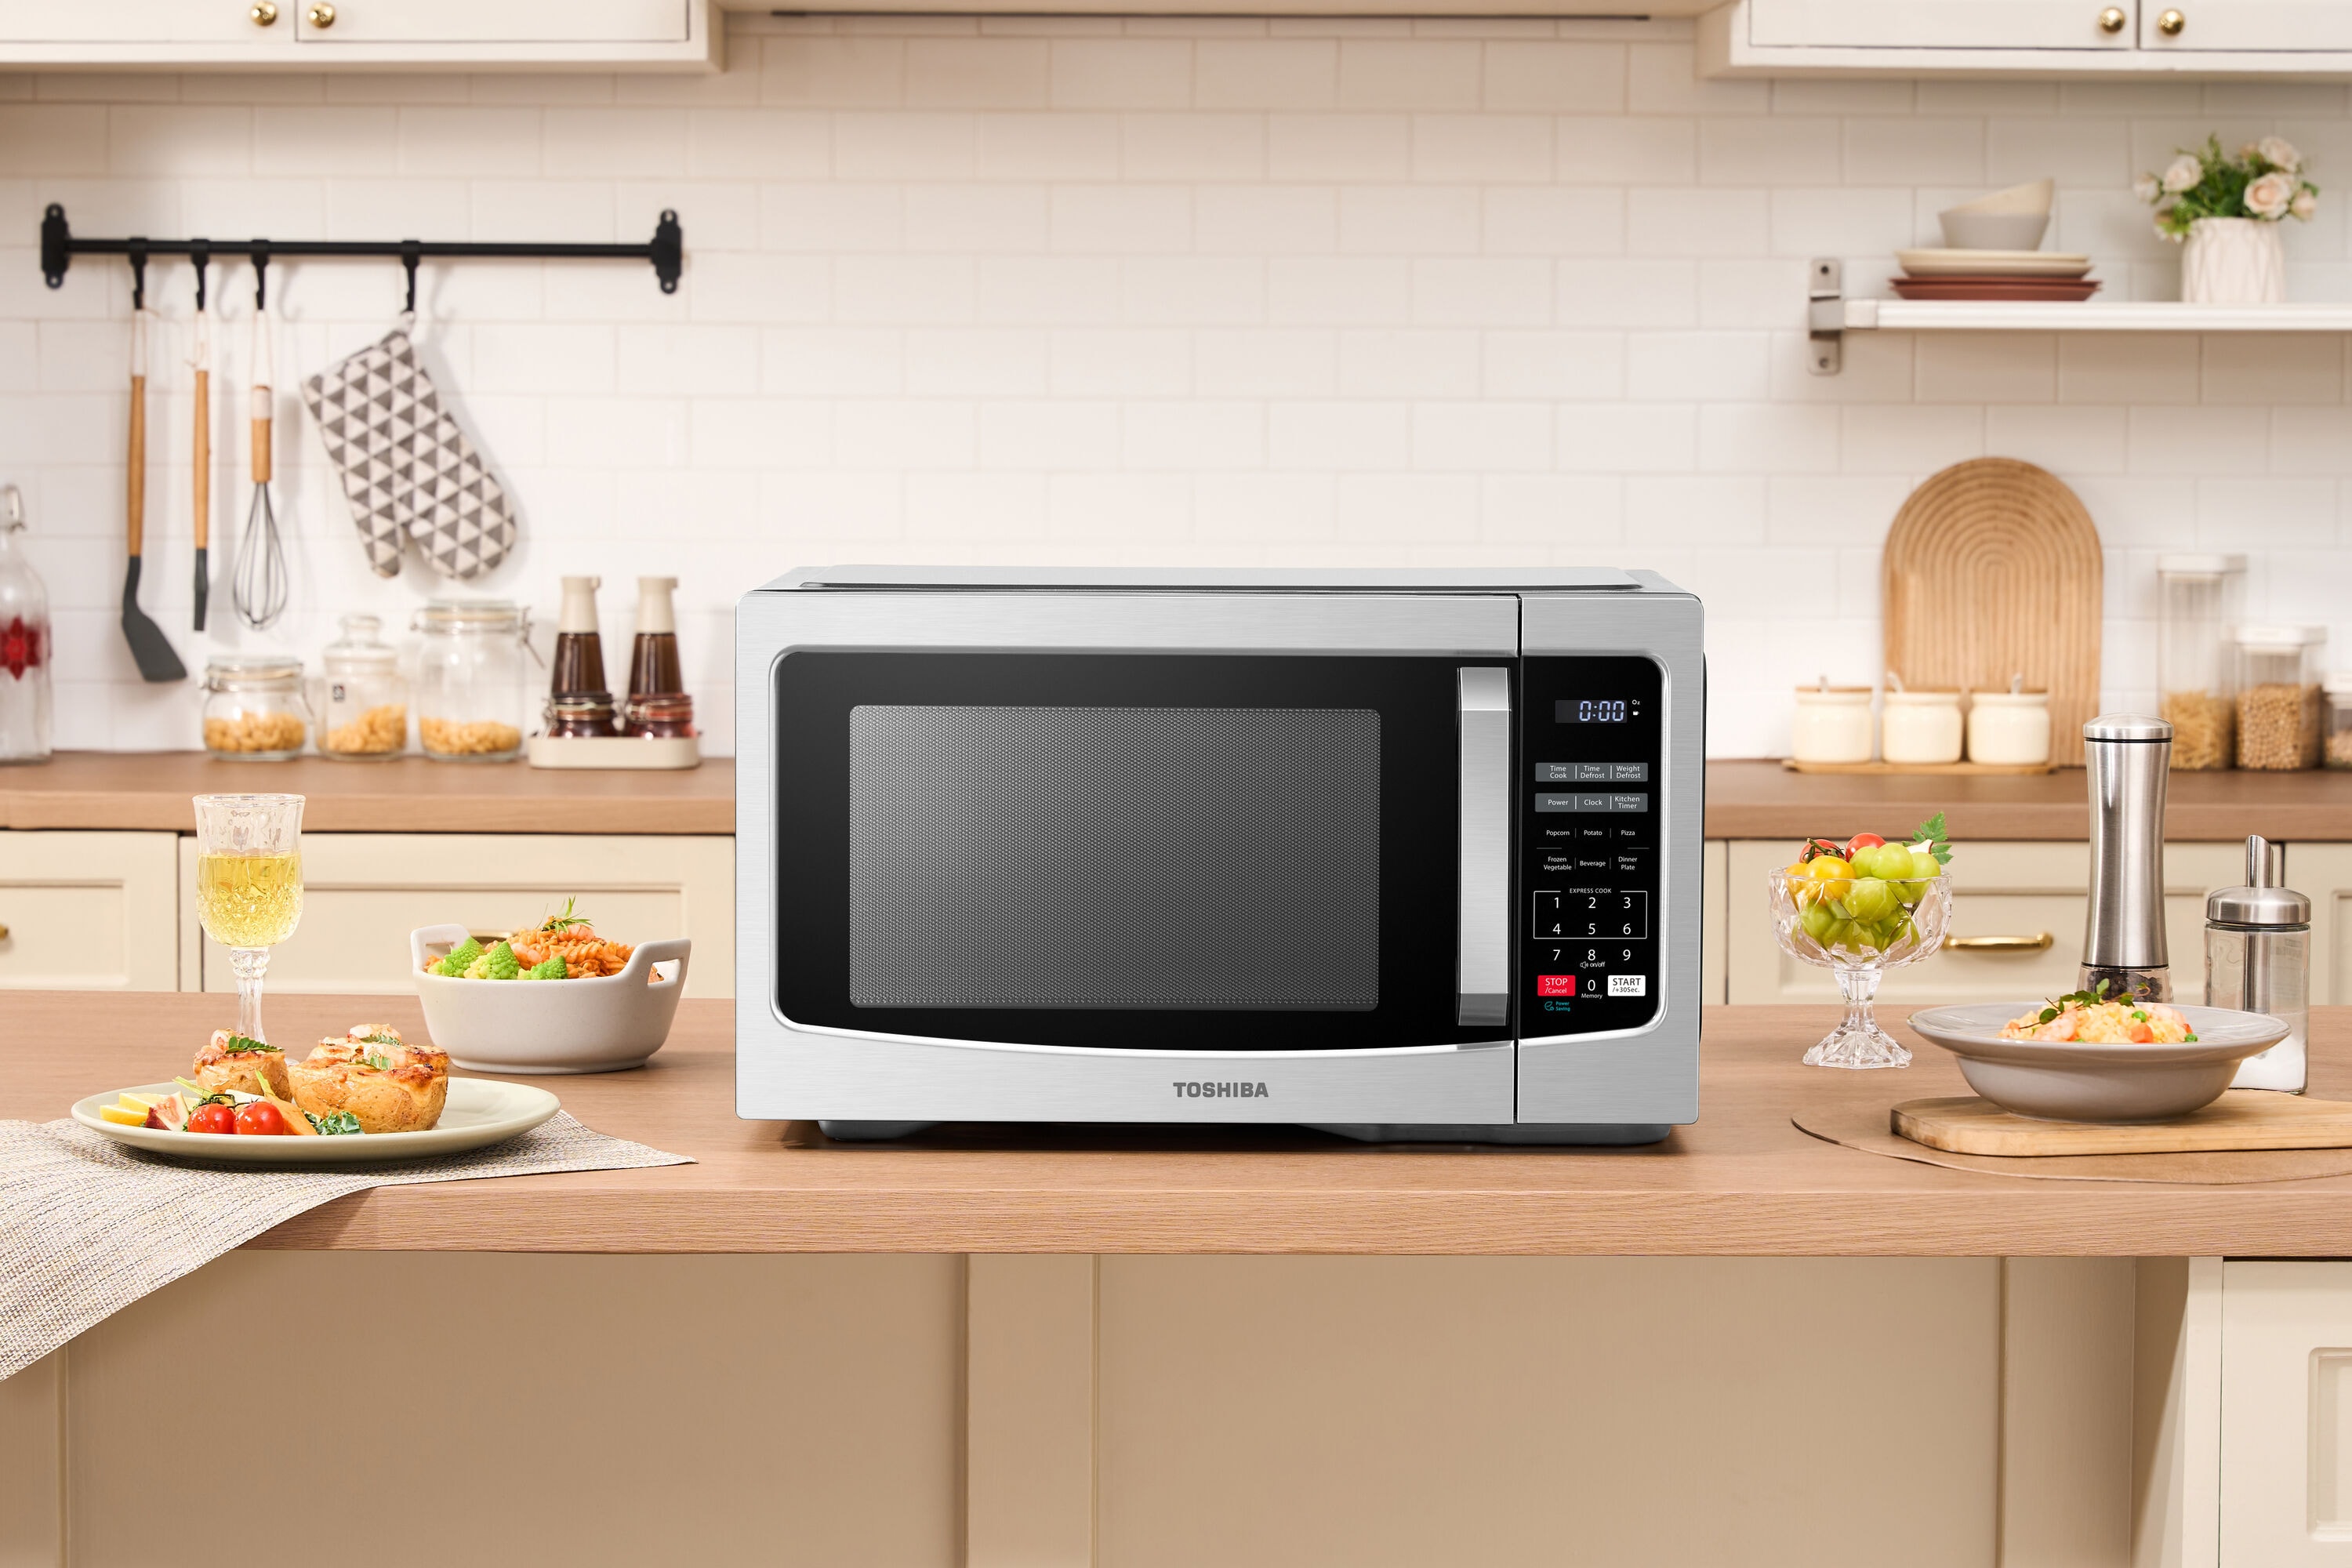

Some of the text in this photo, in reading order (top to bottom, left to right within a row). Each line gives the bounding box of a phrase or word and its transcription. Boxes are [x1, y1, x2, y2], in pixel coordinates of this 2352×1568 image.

[1579, 701, 1624, 722] 0:00
[1588, 896, 1596, 909] 2
[1623, 896, 1632, 909] 3
[1552, 923, 1562, 935] 4
[1588, 923, 1596, 935] 5
[1623, 923, 1632, 935] 6
[1552, 949, 1561, 961] 7
[1588, 949, 1596, 961] 8
[1622, 949, 1632, 961] 9
[1545, 978, 1568, 986] STOP
[1587, 979, 1596, 992] 0
[1612, 978, 1642, 986] START
[1172, 1082, 1269, 1098] TOSHIBA
